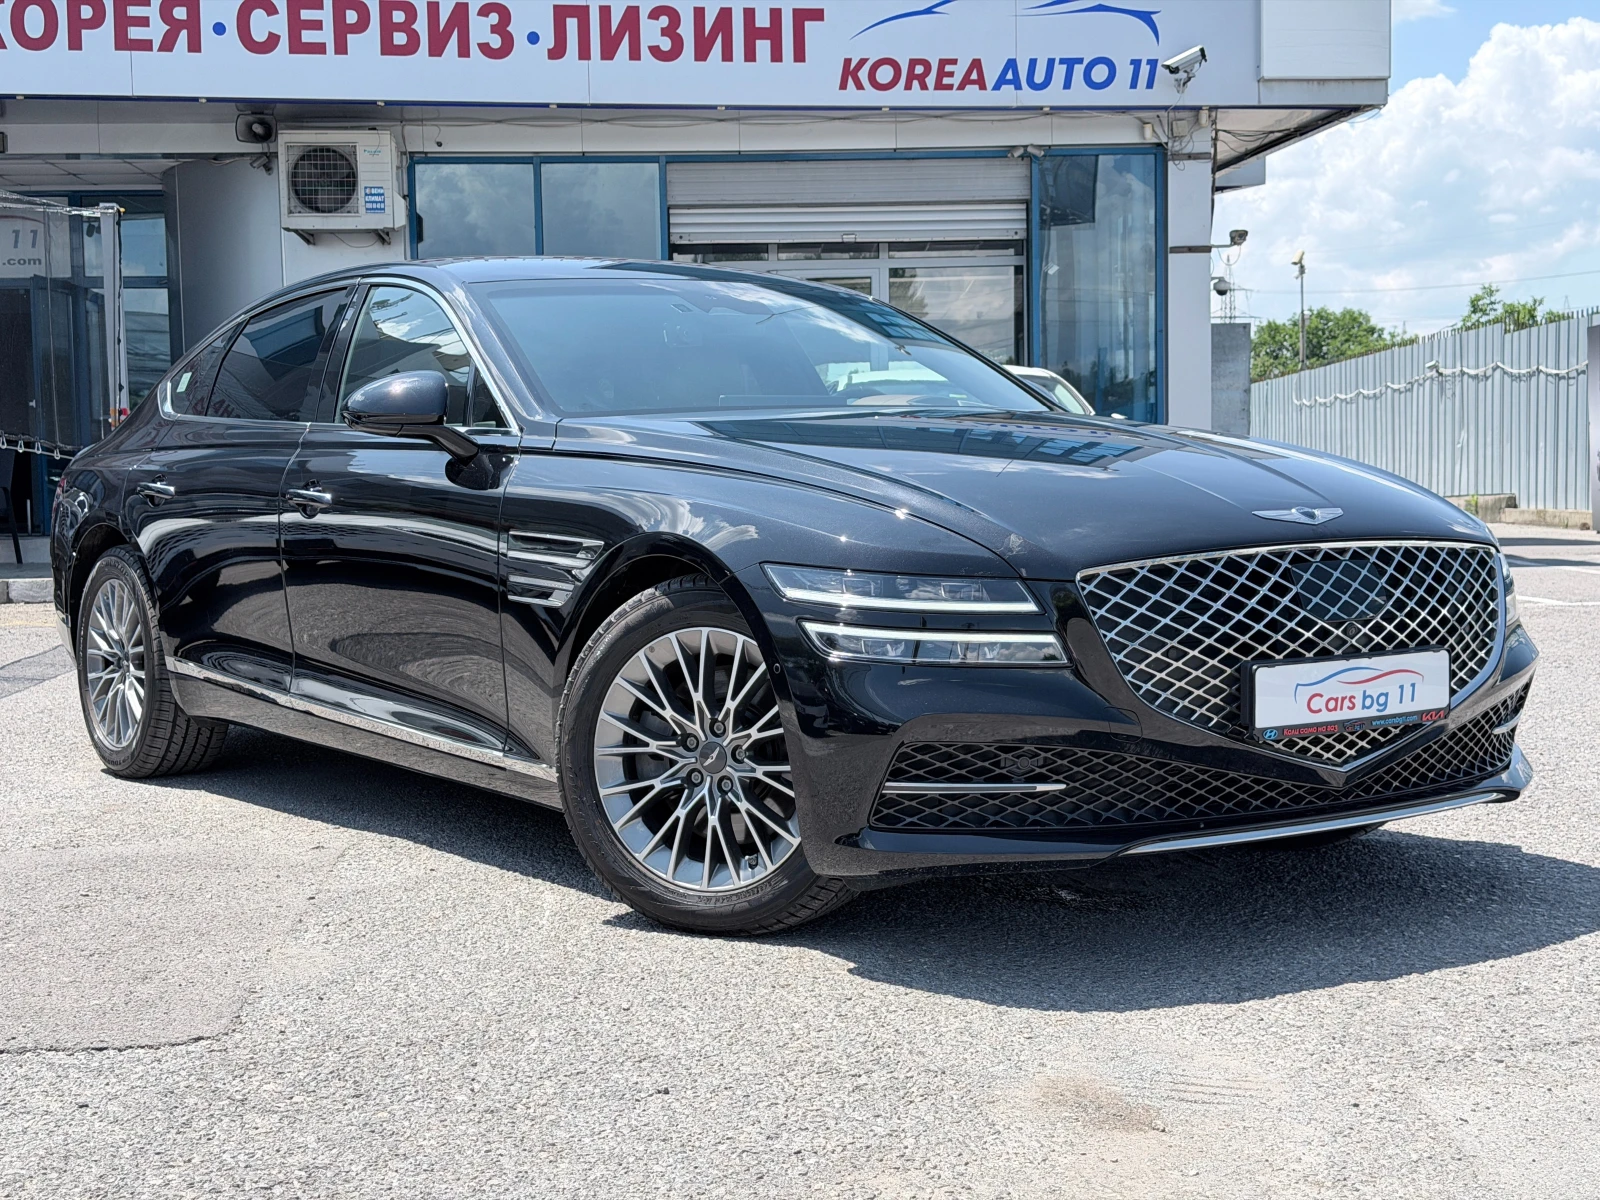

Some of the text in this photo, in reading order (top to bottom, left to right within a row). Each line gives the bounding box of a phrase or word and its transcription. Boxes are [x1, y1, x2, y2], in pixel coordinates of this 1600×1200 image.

[0, 0, 825, 64] ОРЕЯ СЕРВИЗ ЛИЗИНГ
[1129, 58, 1158, 90] 11
[1307, 692, 1357, 714] Cars
[1398, 682, 1416, 704] 11
